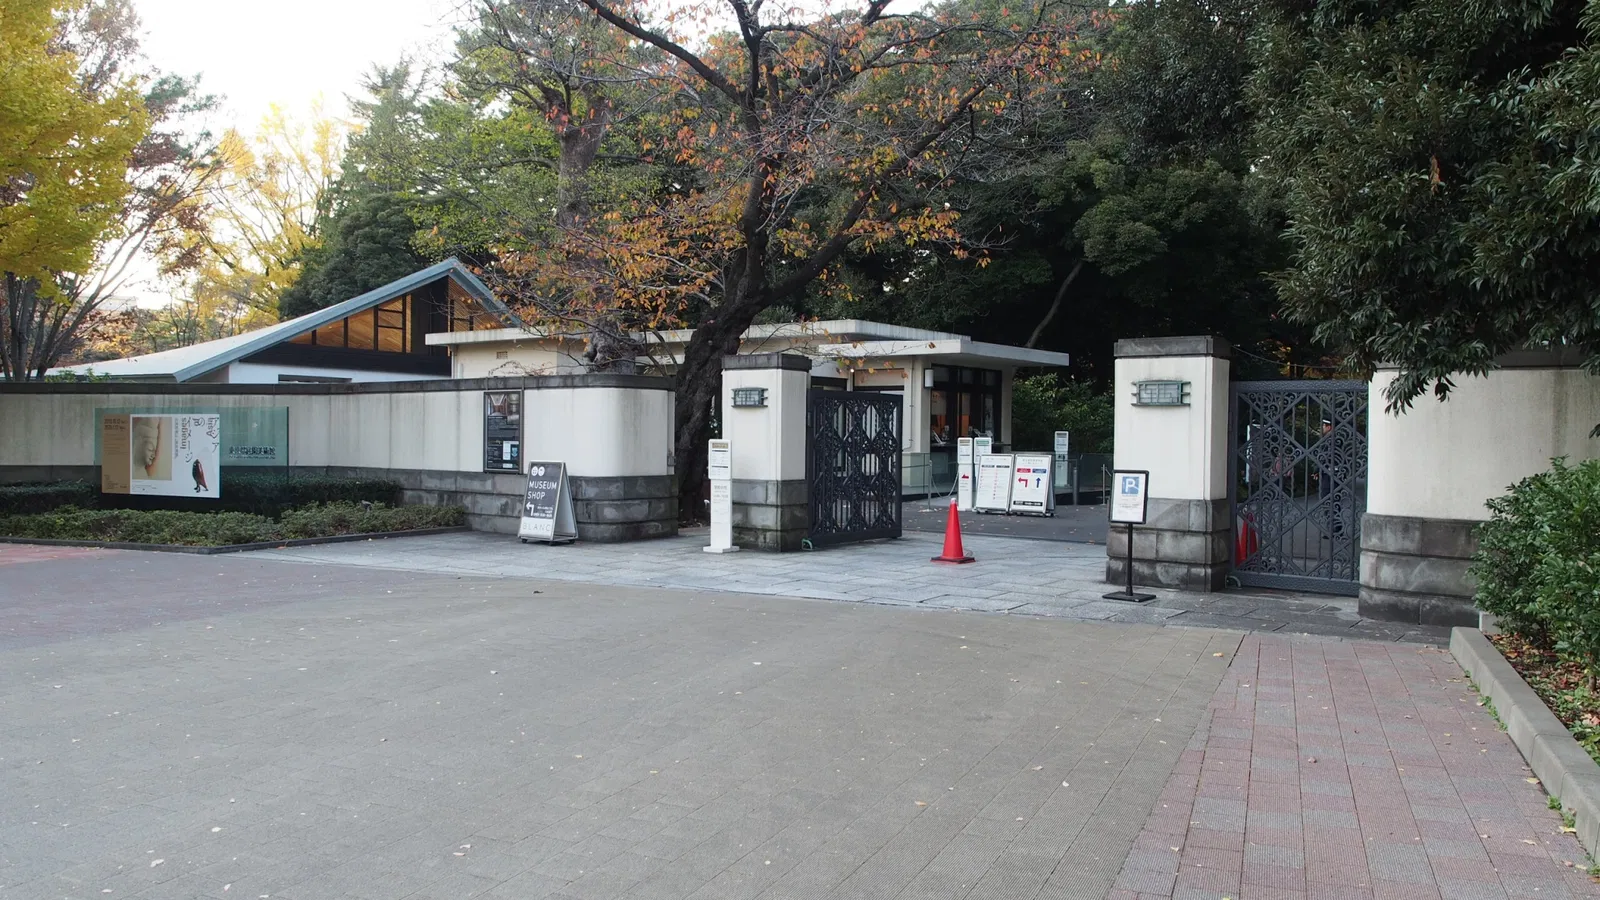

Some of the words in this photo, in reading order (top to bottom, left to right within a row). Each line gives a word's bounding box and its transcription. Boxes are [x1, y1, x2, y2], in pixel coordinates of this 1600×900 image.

[528, 480, 557, 490] MUSEUM
[527, 491, 546, 500] SHOP
[522, 523, 551, 531] BLANC
